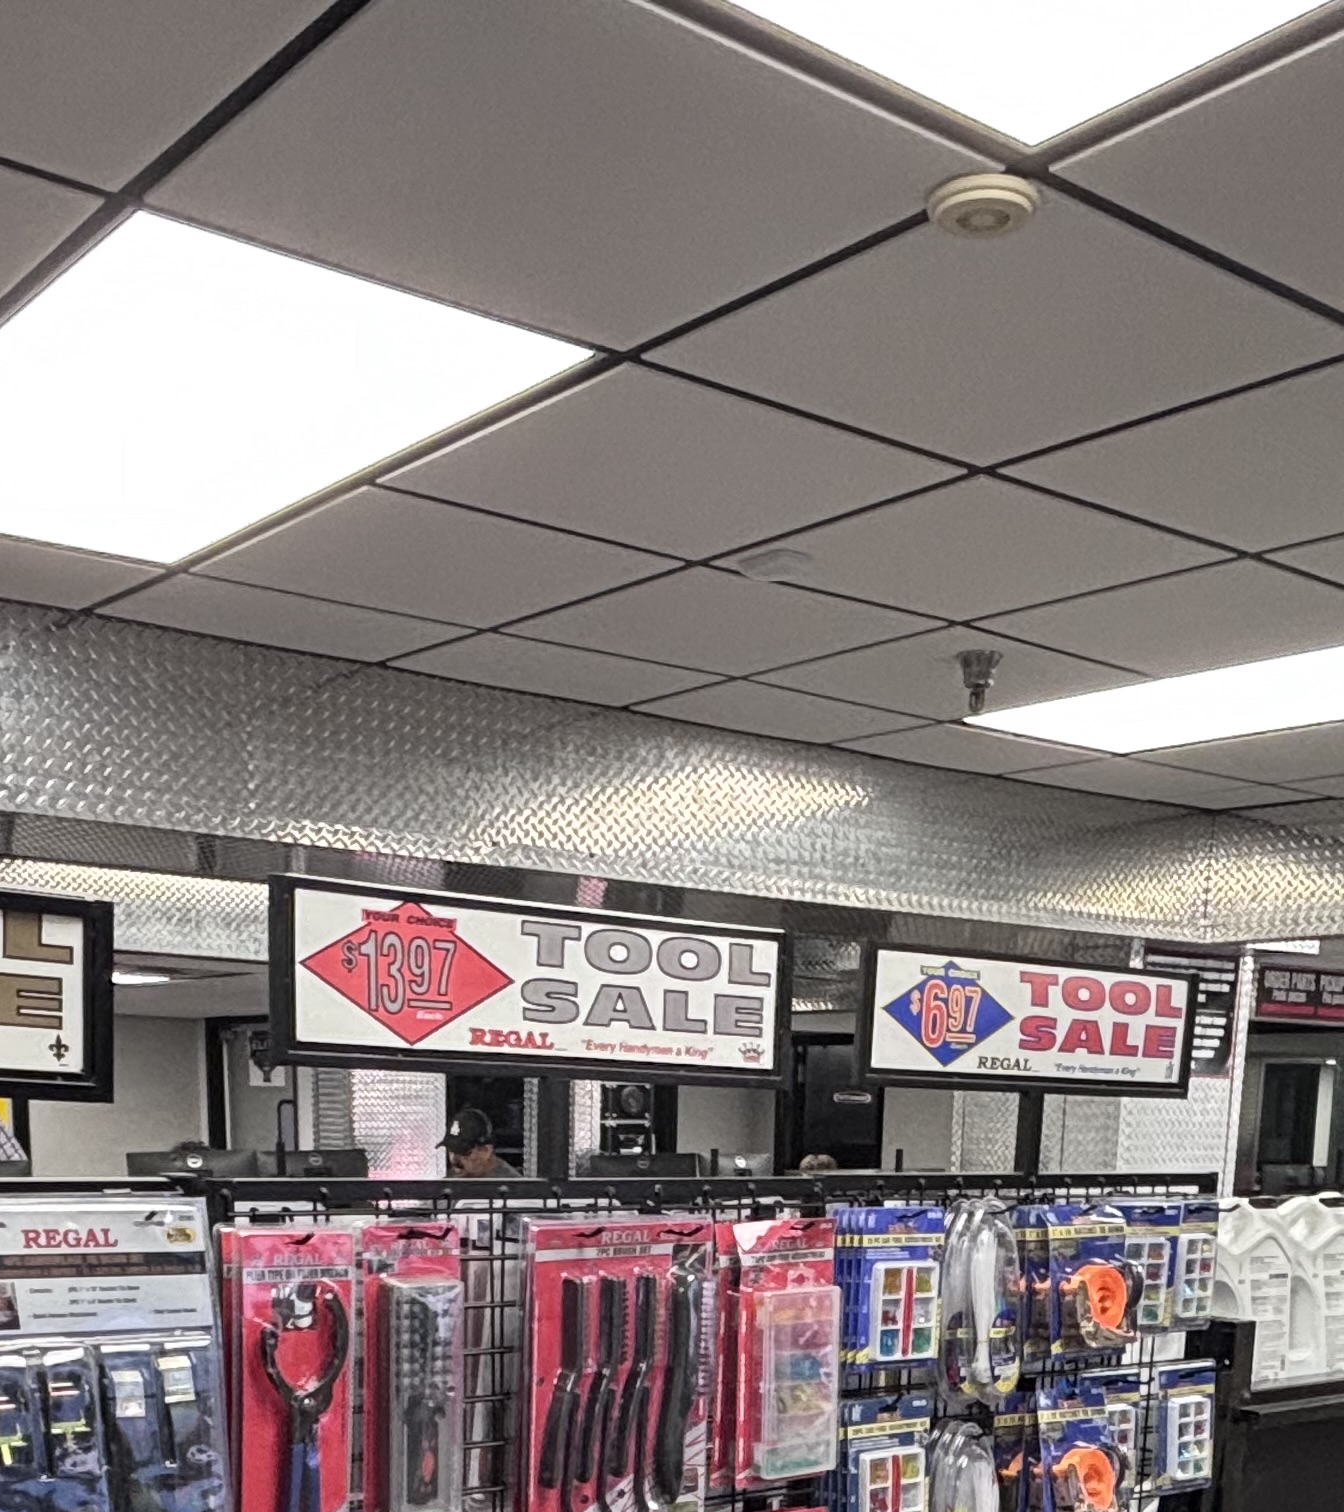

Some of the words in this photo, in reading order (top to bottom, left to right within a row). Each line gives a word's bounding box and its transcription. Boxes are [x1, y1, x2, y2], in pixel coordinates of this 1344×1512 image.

[364, 910, 399, 923] YOUR
[406, 916, 455, 929] CHOICE
[520, 919, 772, 988] TOOL
[1020, 970, 1183, 1019] TOOL
[520, 978, 764, 1038] SALE
[469, 1027, 554, 1050] REGAL
[1018, 1015, 1177, 1060] SALE
[619, 1041, 673, 1057] Handyman
[976, 1056, 1033, 1073] REGAL
[21, 1228, 118, 1249] REGAL
[601, 1229, 651, 1245] REGAL
[274, 1252, 321, 1266] REGAL
